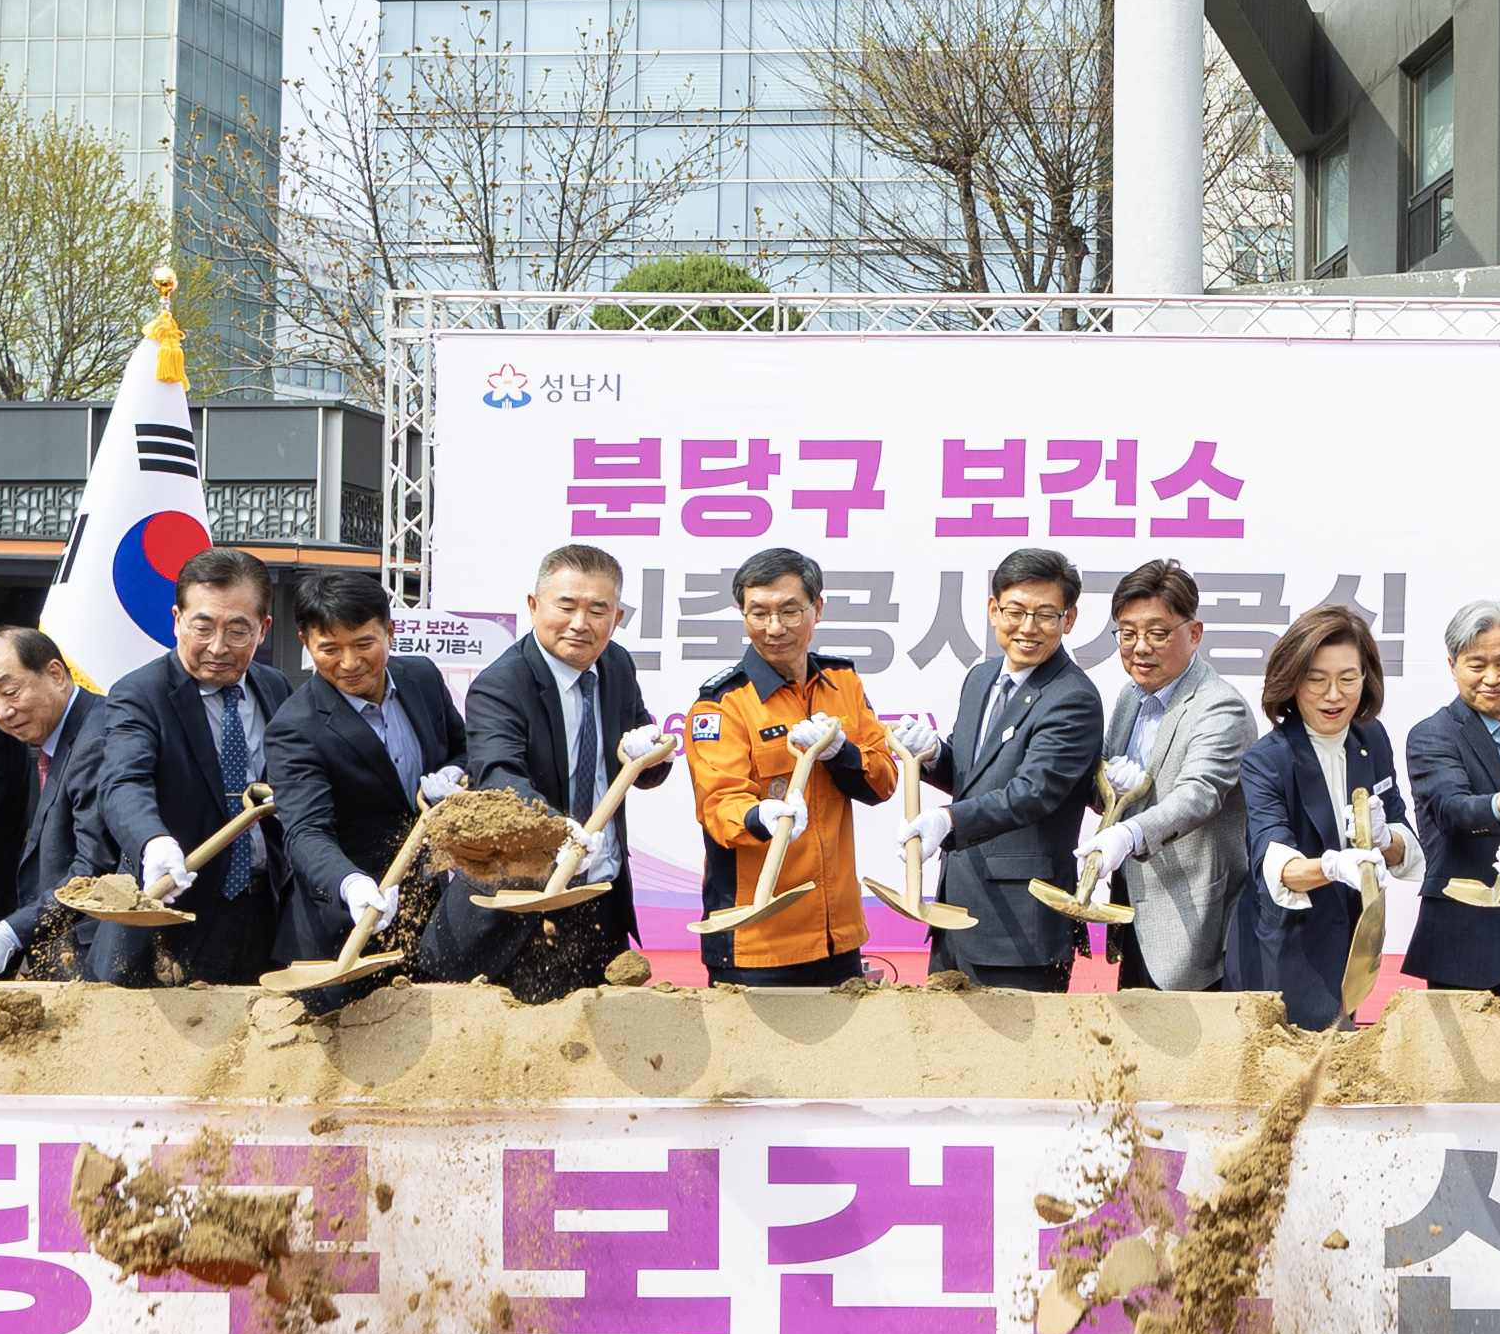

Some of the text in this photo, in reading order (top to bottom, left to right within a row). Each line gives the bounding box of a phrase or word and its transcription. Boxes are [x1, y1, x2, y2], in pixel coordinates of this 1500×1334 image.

[539, 373, 622, 403] 성남시
[567, 438, 1245, 539] 분당구 보건소
[393, 619, 469, 636] 당구 보건소
[390, 638, 483, 656] 공사 기공식
